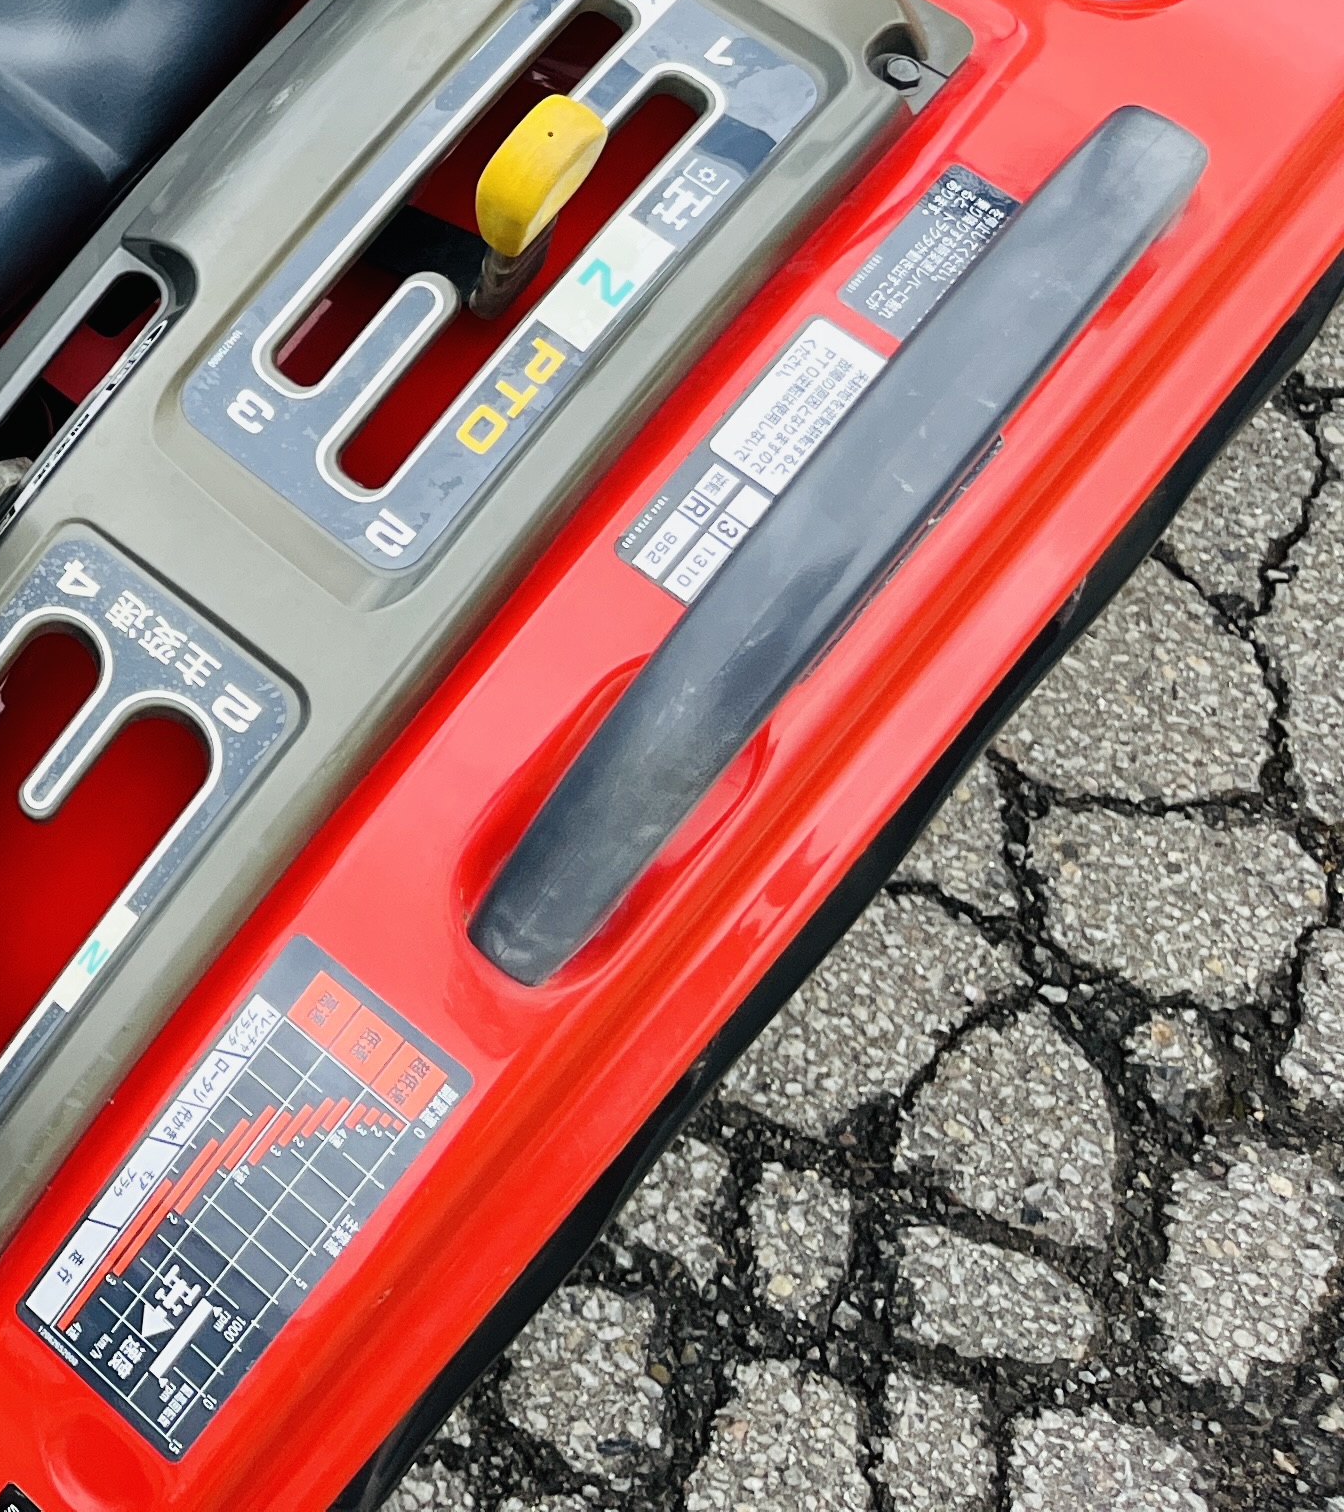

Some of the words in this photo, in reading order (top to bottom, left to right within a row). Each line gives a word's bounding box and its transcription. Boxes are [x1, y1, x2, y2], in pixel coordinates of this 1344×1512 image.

[704, 36, 733, 67] 1
[920, 178, 961, 216] あります。
[578, 258, 633, 306] N
[774, 336, 818, 378] ください。
[226, 391, 275, 433] 3
[455, 337, 566, 455] PTO
[749, 356, 853, 475] 故障の原因となりますので
[681, 495, 709, 520] R
[364, 507, 418, 557] 2
[714, 517, 739, 541] 3
[647, 531, 680, 570] 952
[674, 545, 720, 589] 1310
[56, 559, 102, 601] 4
[108, 592, 225, 686] 主変速
[212, 682, 261, 732] 2
[78, 939, 110, 975] N
[304, 989, 341, 1029] 高速
[237, 1007, 276, 1055] トレンチャ
[347, 1026, 382, 1063] 低速
[189, 1055, 230, 1104] ロータリ
[384, 1054, 431, 1108] 超低速
[161, 1104, 193, 1141] 代かき
[134, 1167, 154, 1190] モア
[54, 1248, 86, 1285] 走行
[210, 1309, 232, 1332] rpm
[220, 1313, 247, 1343] 1000
[88, 1332, 113, 1361] km/h
[104, 1333, 147, 1380] 速度
[201, 1394, 217, 1410] 10
